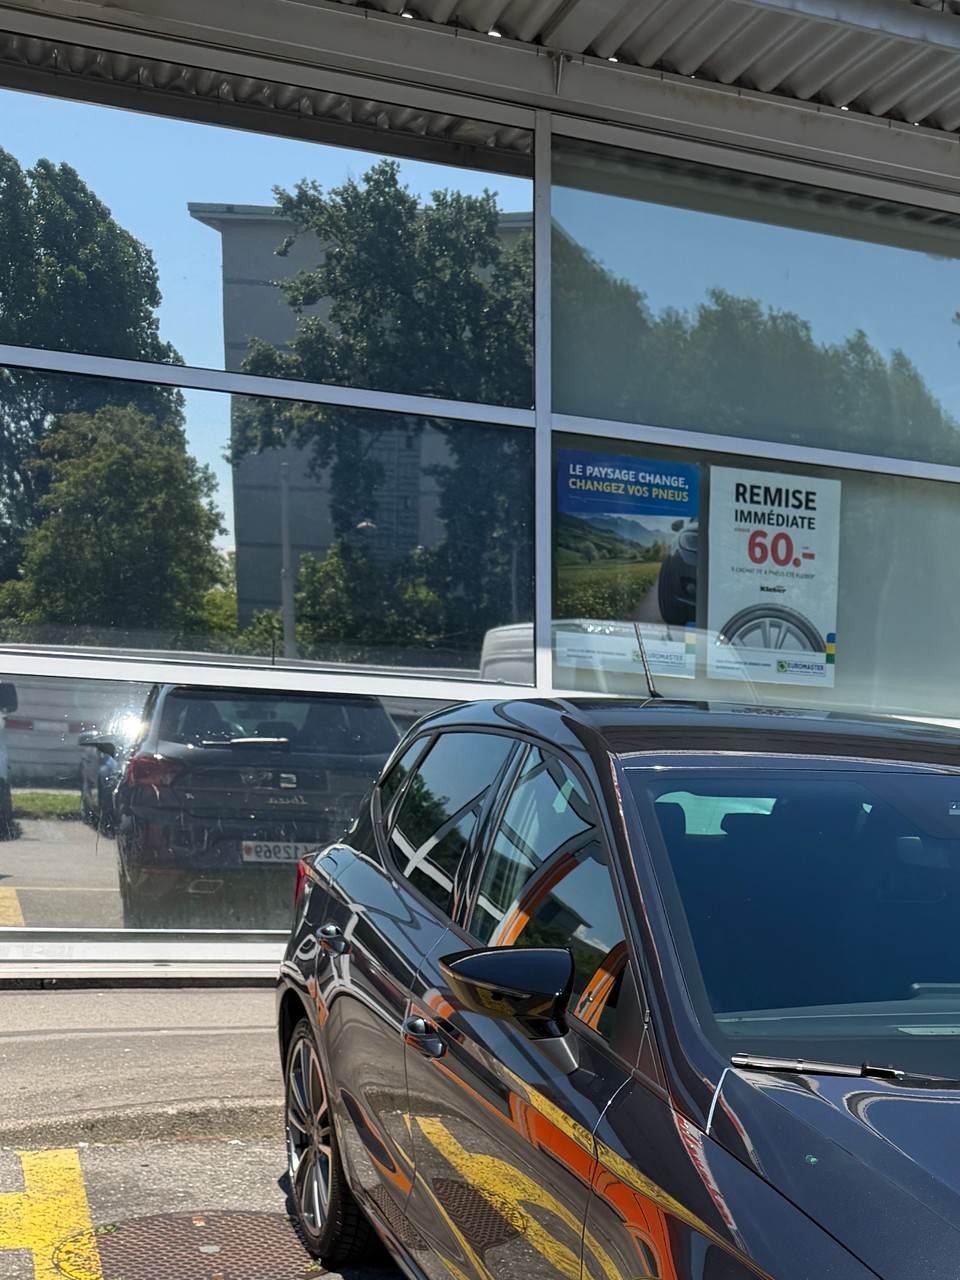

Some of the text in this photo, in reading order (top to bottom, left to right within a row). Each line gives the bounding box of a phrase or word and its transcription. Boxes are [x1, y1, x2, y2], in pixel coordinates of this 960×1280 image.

[569, 464, 689, 489] LE PAYSAGE CHANGE,
[568, 478, 689, 502] CHANGEZ VOS PNEUS
[735, 482, 817, 511] REMISE
[735, 509, 816, 530] IMMÉDIATE
[646, 652, 684, 661] UROMASTER
[787, 662, 824, 671] EUROMASTER
